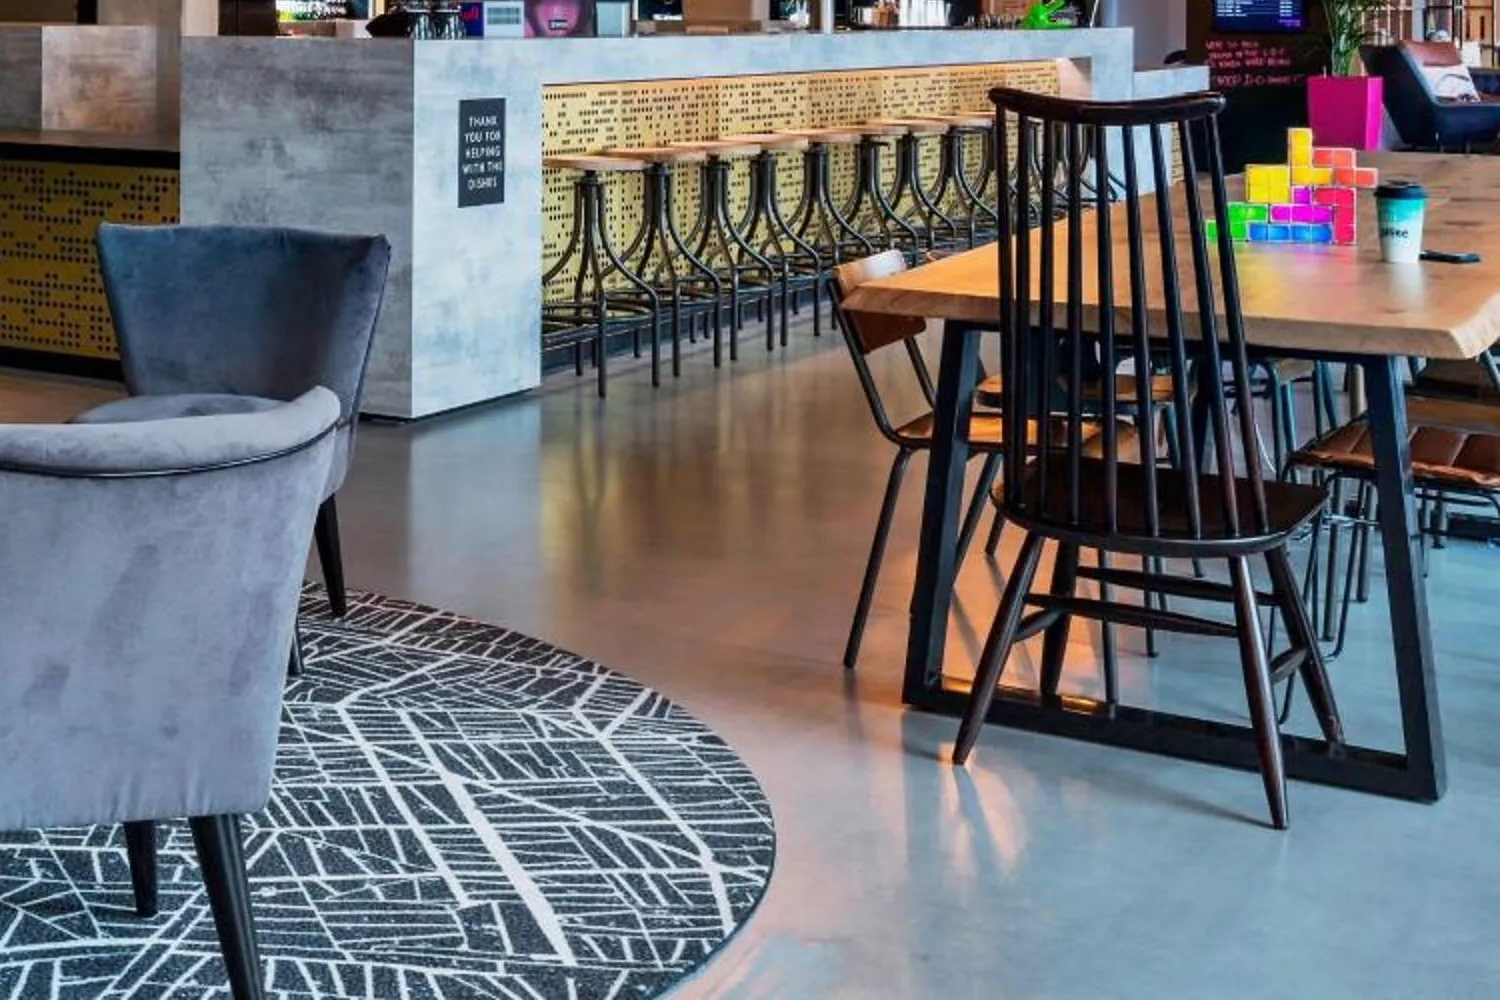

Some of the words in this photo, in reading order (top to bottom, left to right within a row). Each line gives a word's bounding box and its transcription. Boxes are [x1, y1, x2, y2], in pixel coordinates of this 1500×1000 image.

[468, 115, 498, 127] THANK
[463, 131, 483, 143] YOU
[465, 145, 501, 159] HELPING
[462, 162, 485, 175] WITH
